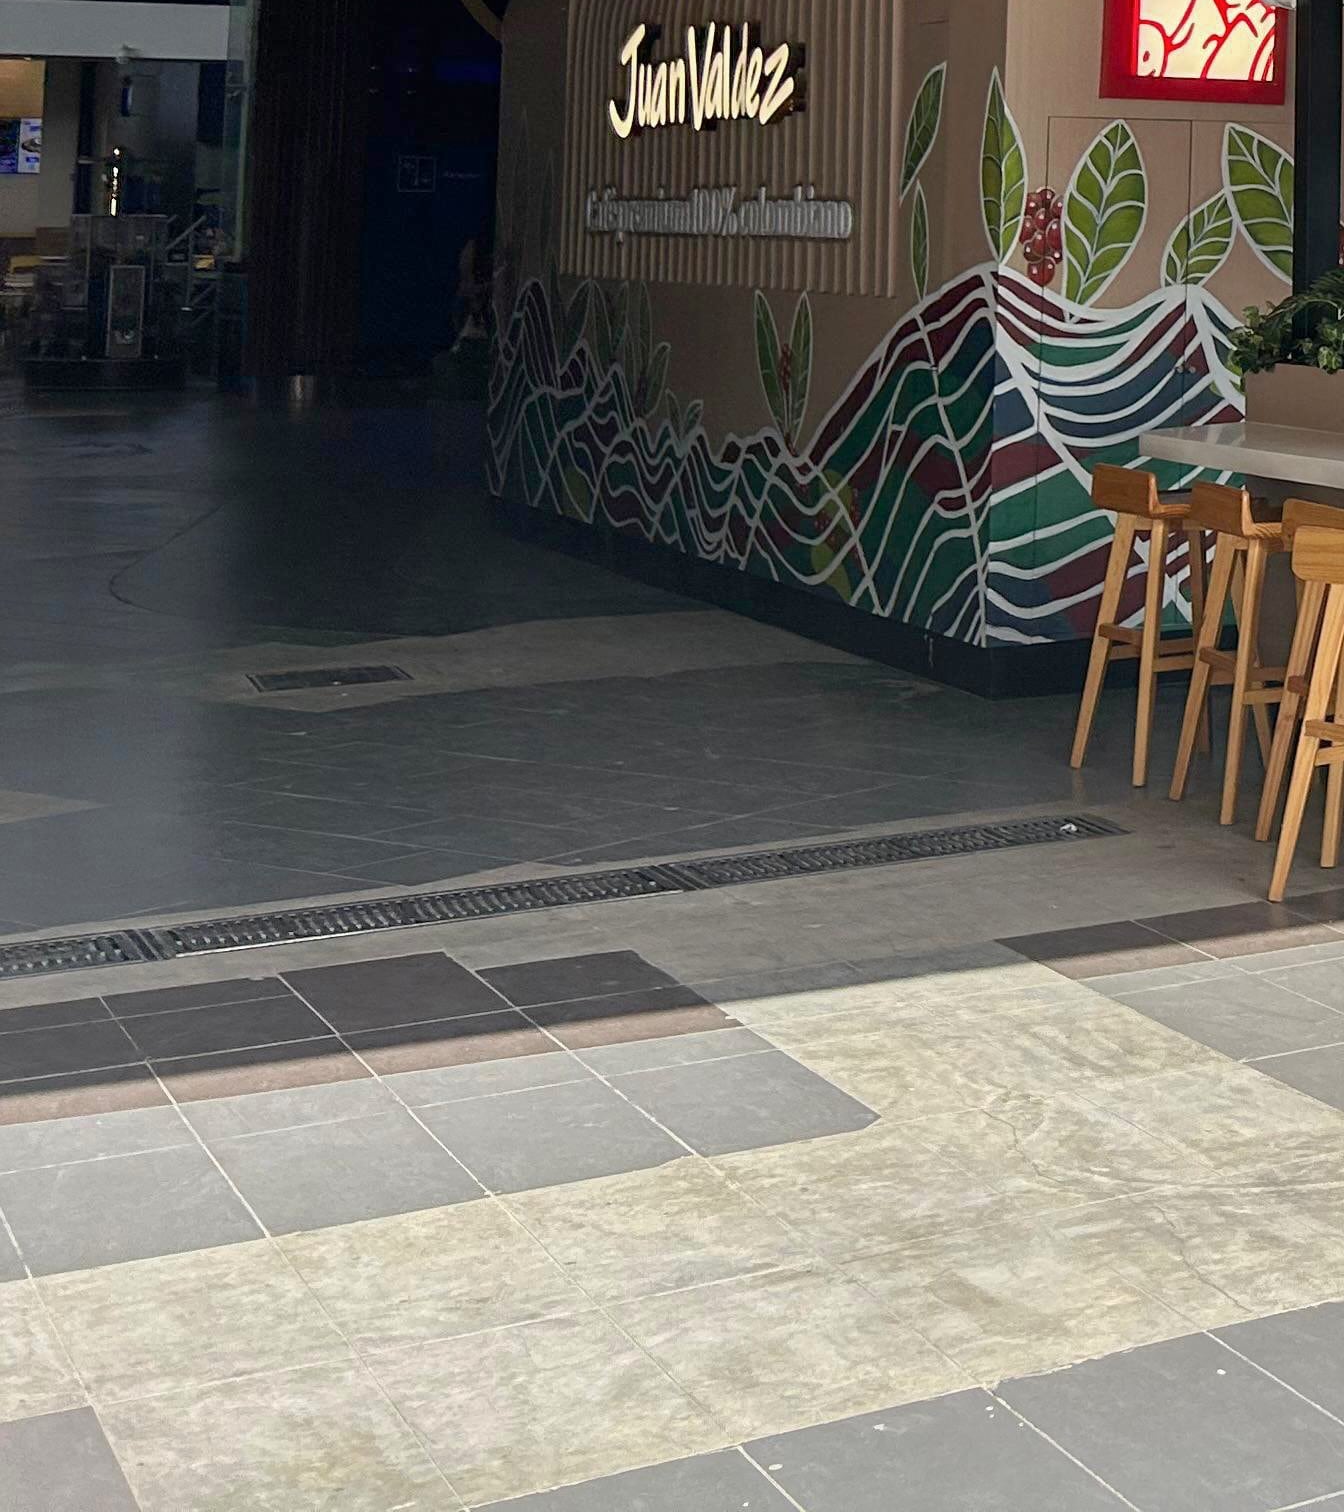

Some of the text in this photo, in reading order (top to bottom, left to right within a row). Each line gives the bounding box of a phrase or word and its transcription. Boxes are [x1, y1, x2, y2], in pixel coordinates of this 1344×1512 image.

[609, 21, 795, 138] Juan Valdez
[691, 187, 738, 236] 100%
[738, 186, 852, 238] colombiano
